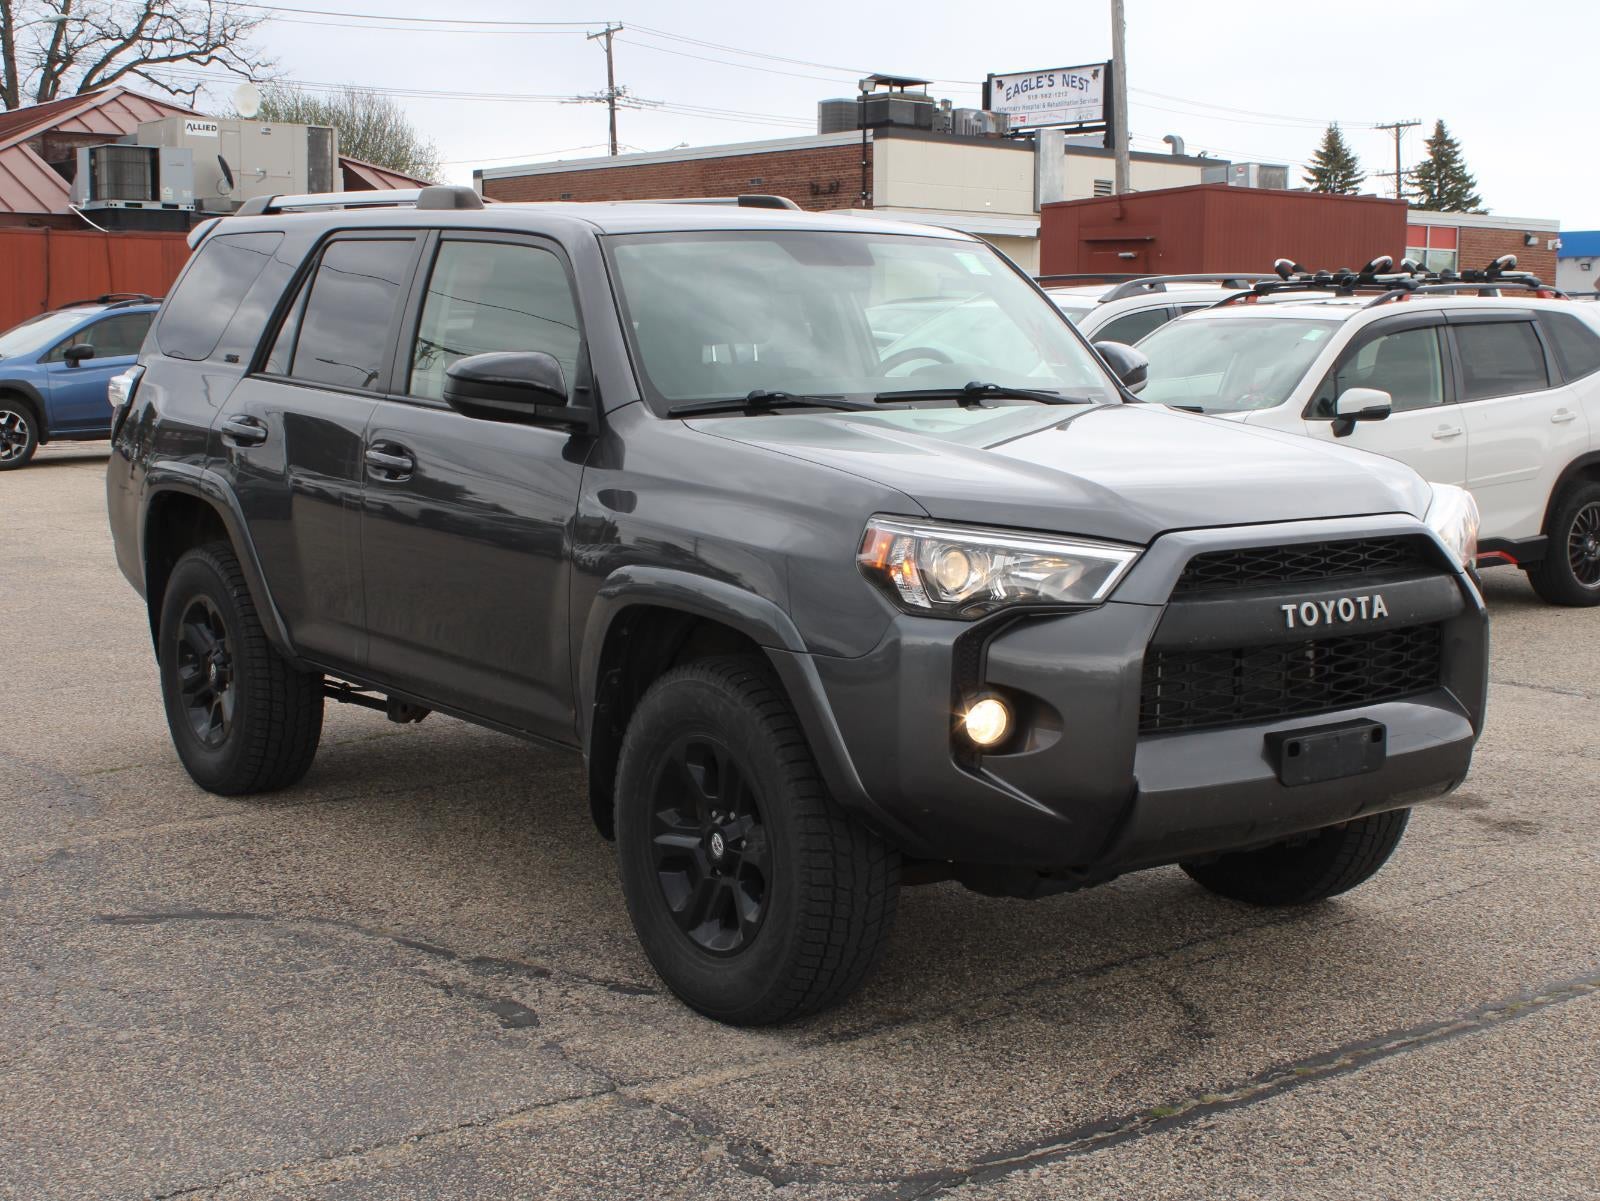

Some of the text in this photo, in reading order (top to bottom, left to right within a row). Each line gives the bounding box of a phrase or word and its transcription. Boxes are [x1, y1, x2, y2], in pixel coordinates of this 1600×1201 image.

[1005, 74, 1090, 102] EAGLE'S NEST
[996, 104, 1021, 113] Veterinary
[186, 122, 217, 132] ALLIED
[1281, 594, 1389, 628] TOYOTA
